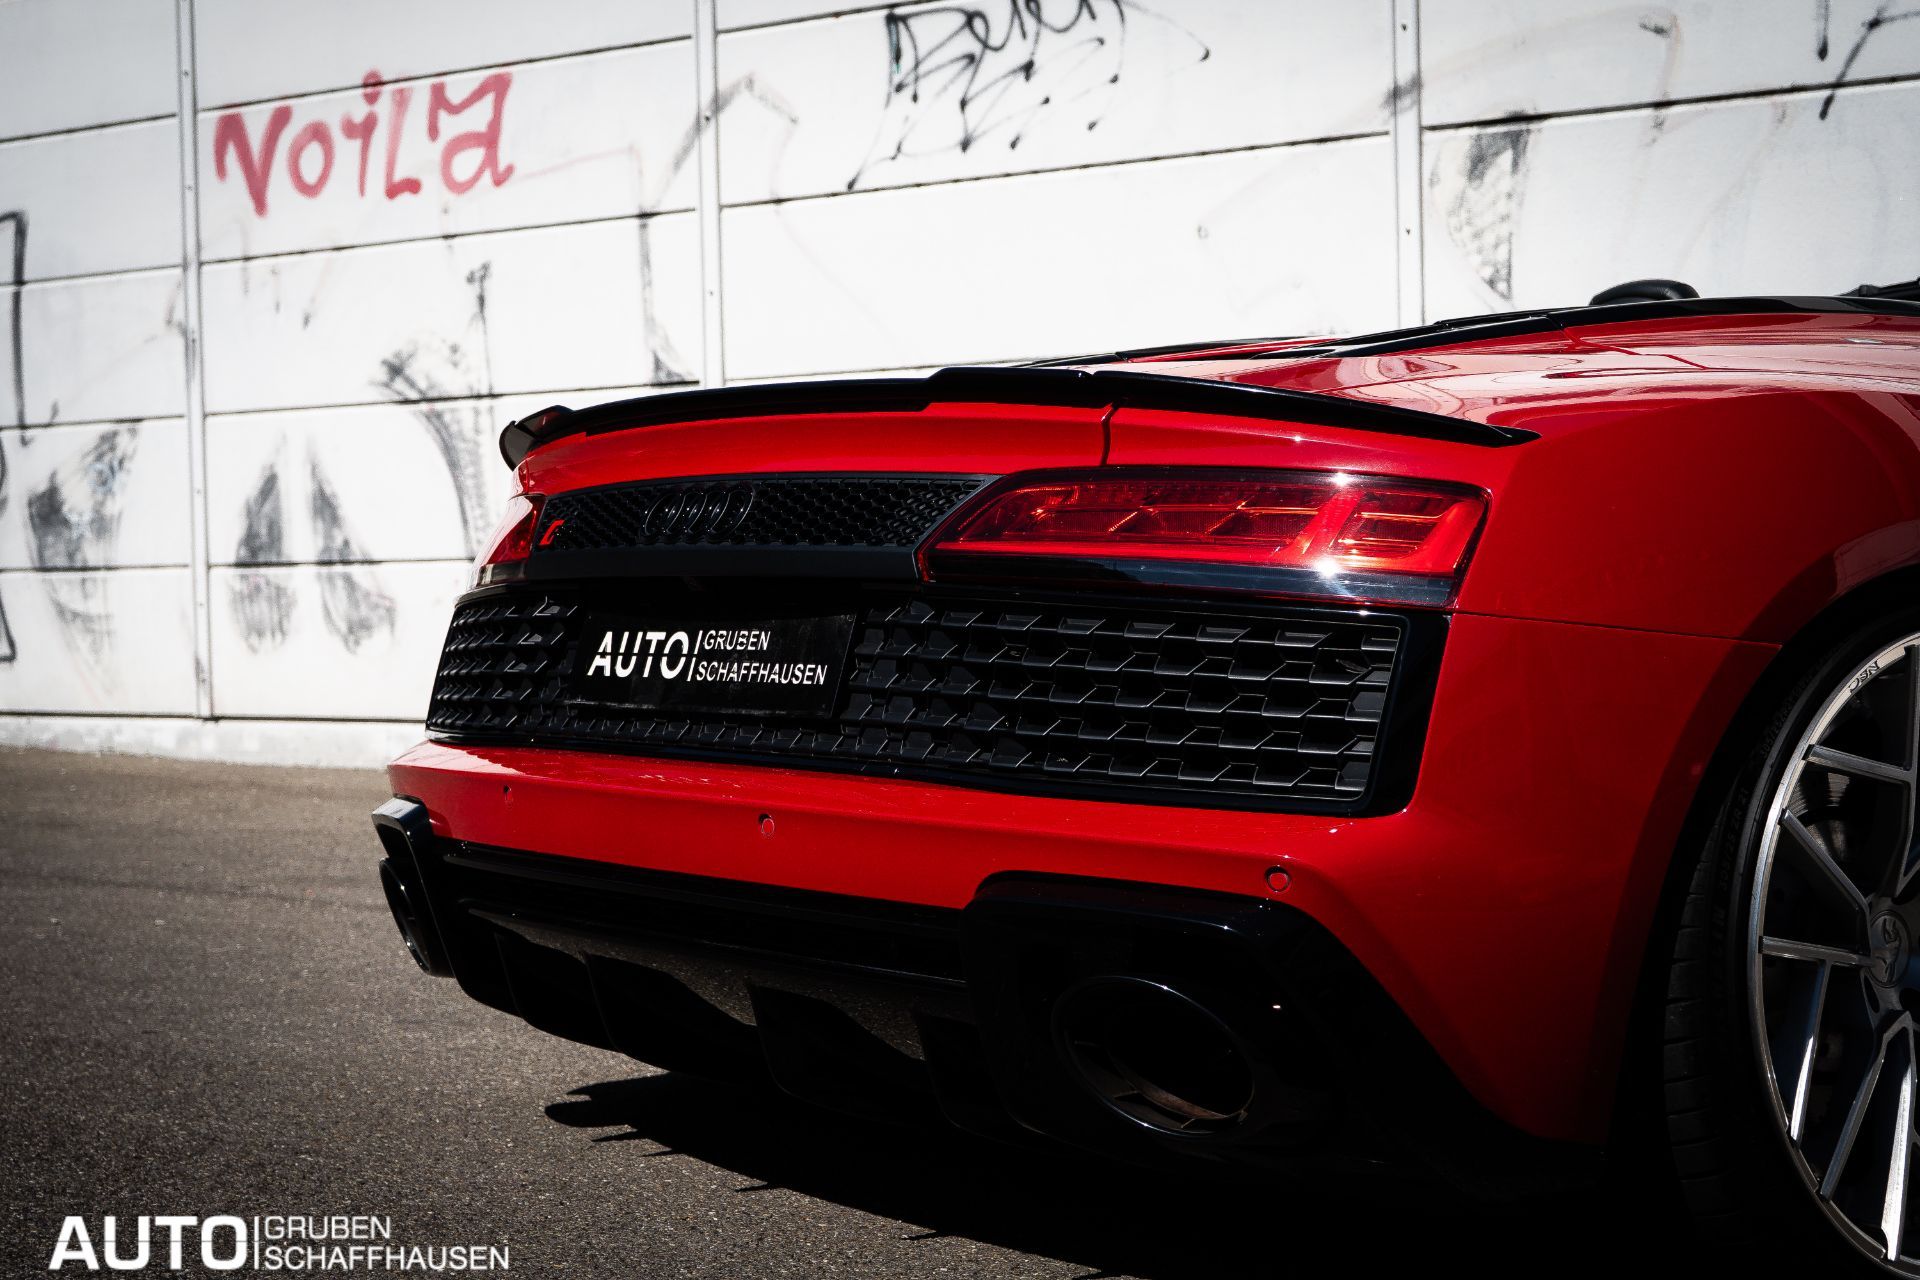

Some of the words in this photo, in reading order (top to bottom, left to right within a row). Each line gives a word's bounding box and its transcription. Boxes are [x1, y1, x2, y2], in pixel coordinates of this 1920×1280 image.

[703, 629, 771, 651] GRUBEN
[587, 631, 689, 680] AUTO
[696, 660, 828, 686] SCHAFFHAUSEN
